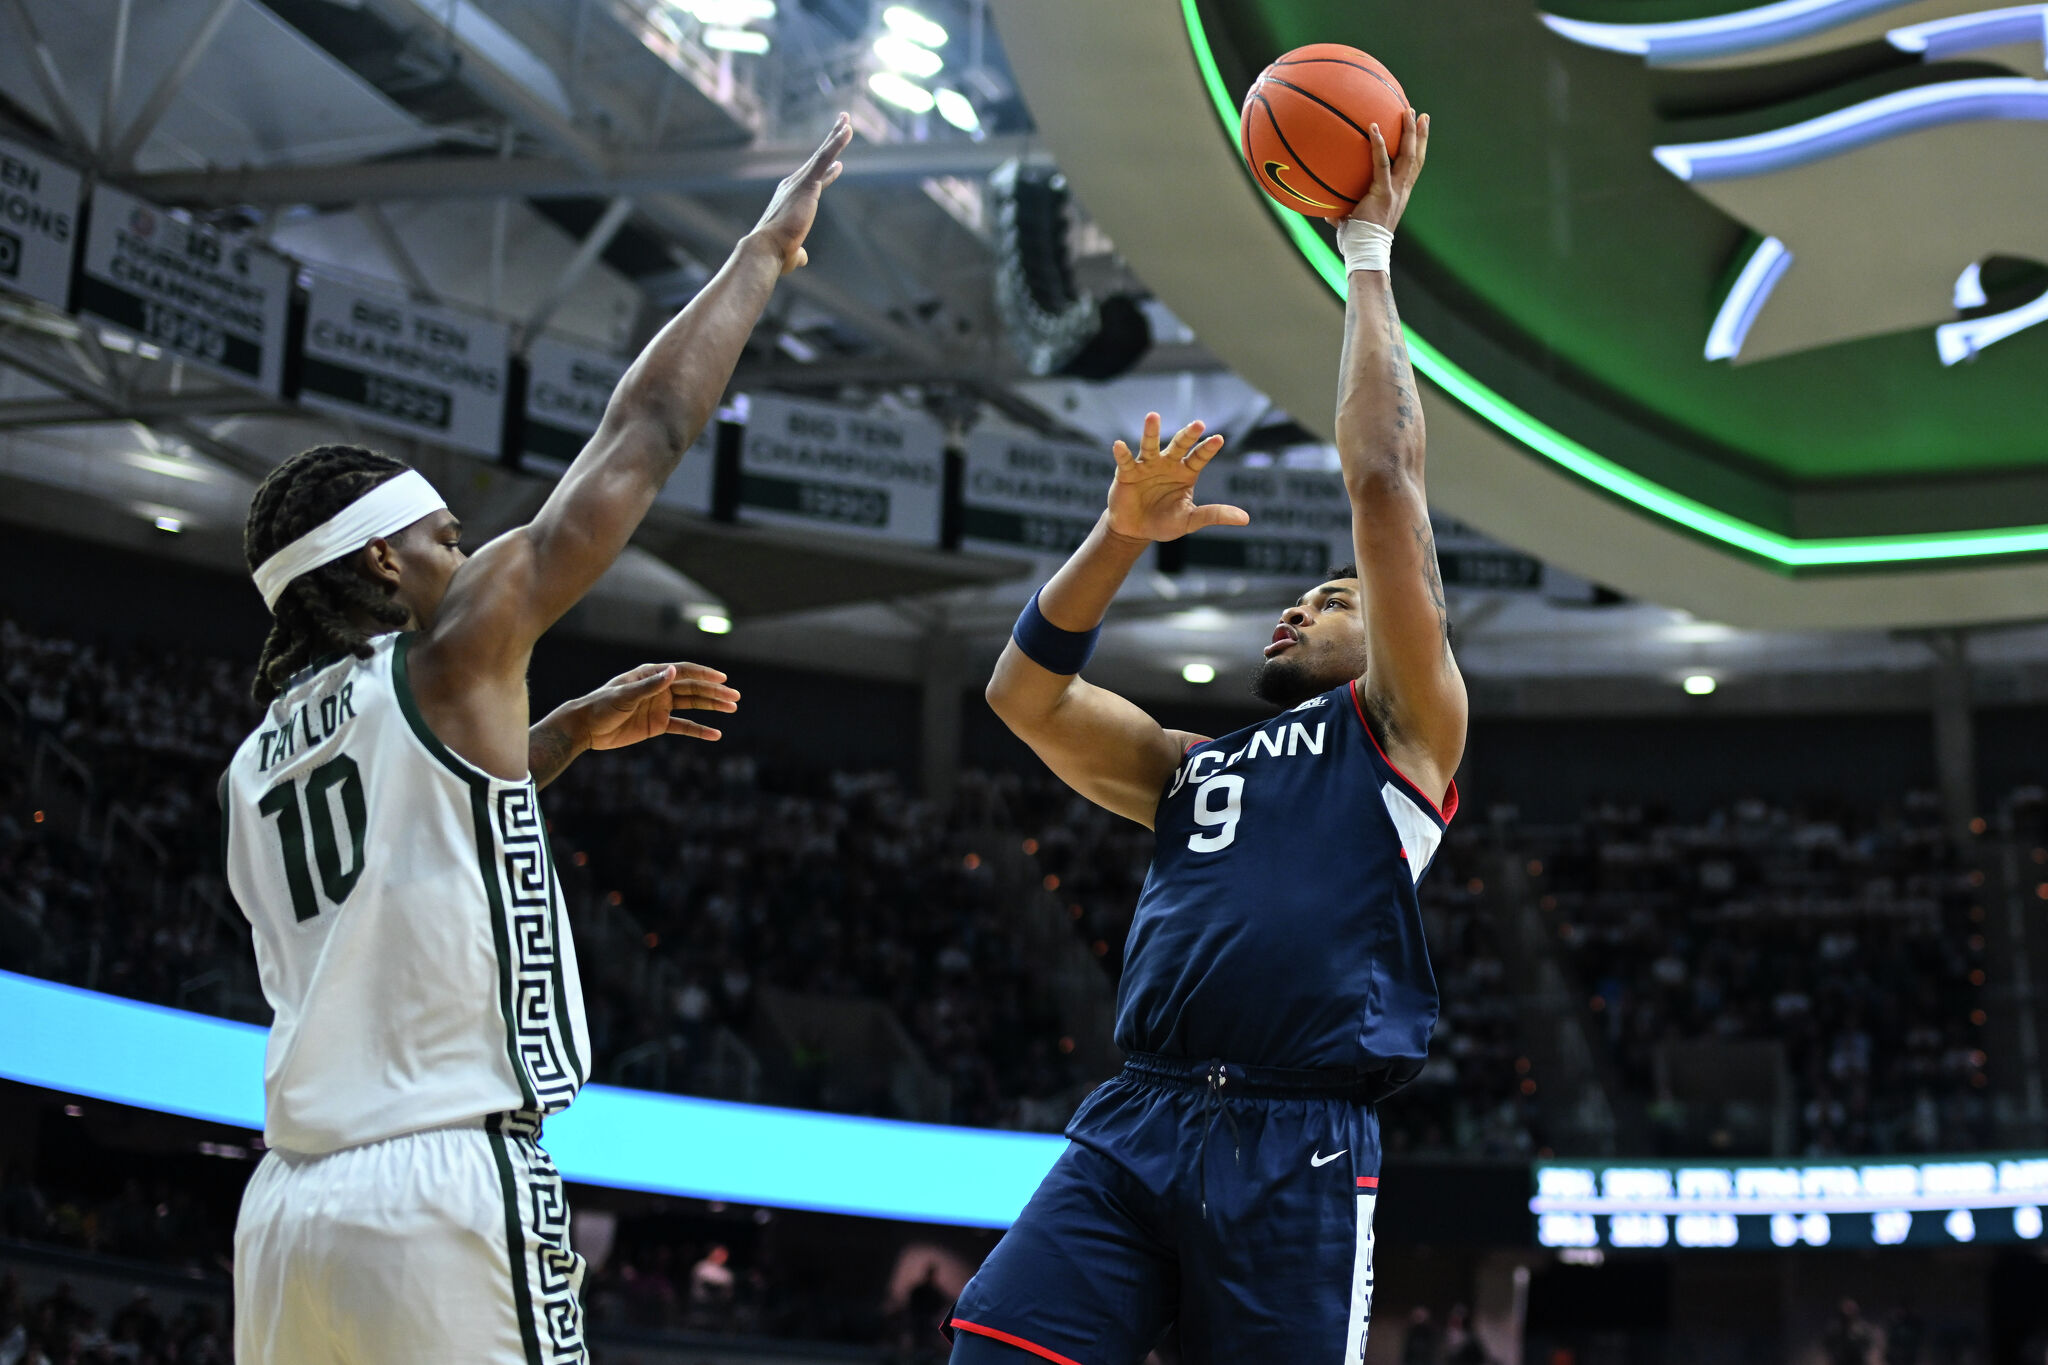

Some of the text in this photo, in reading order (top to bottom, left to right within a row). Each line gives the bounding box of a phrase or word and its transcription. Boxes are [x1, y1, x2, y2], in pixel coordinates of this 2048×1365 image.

[0, 150, 41, 194] EN
[312, 318, 500, 395] CHAMPIONS
[352, 299, 468, 352] BIG TEN
[258, 681, 357, 772] TAYLOR
[258, 753, 367, 923] 10
[1187, 774, 1245, 853] 9
